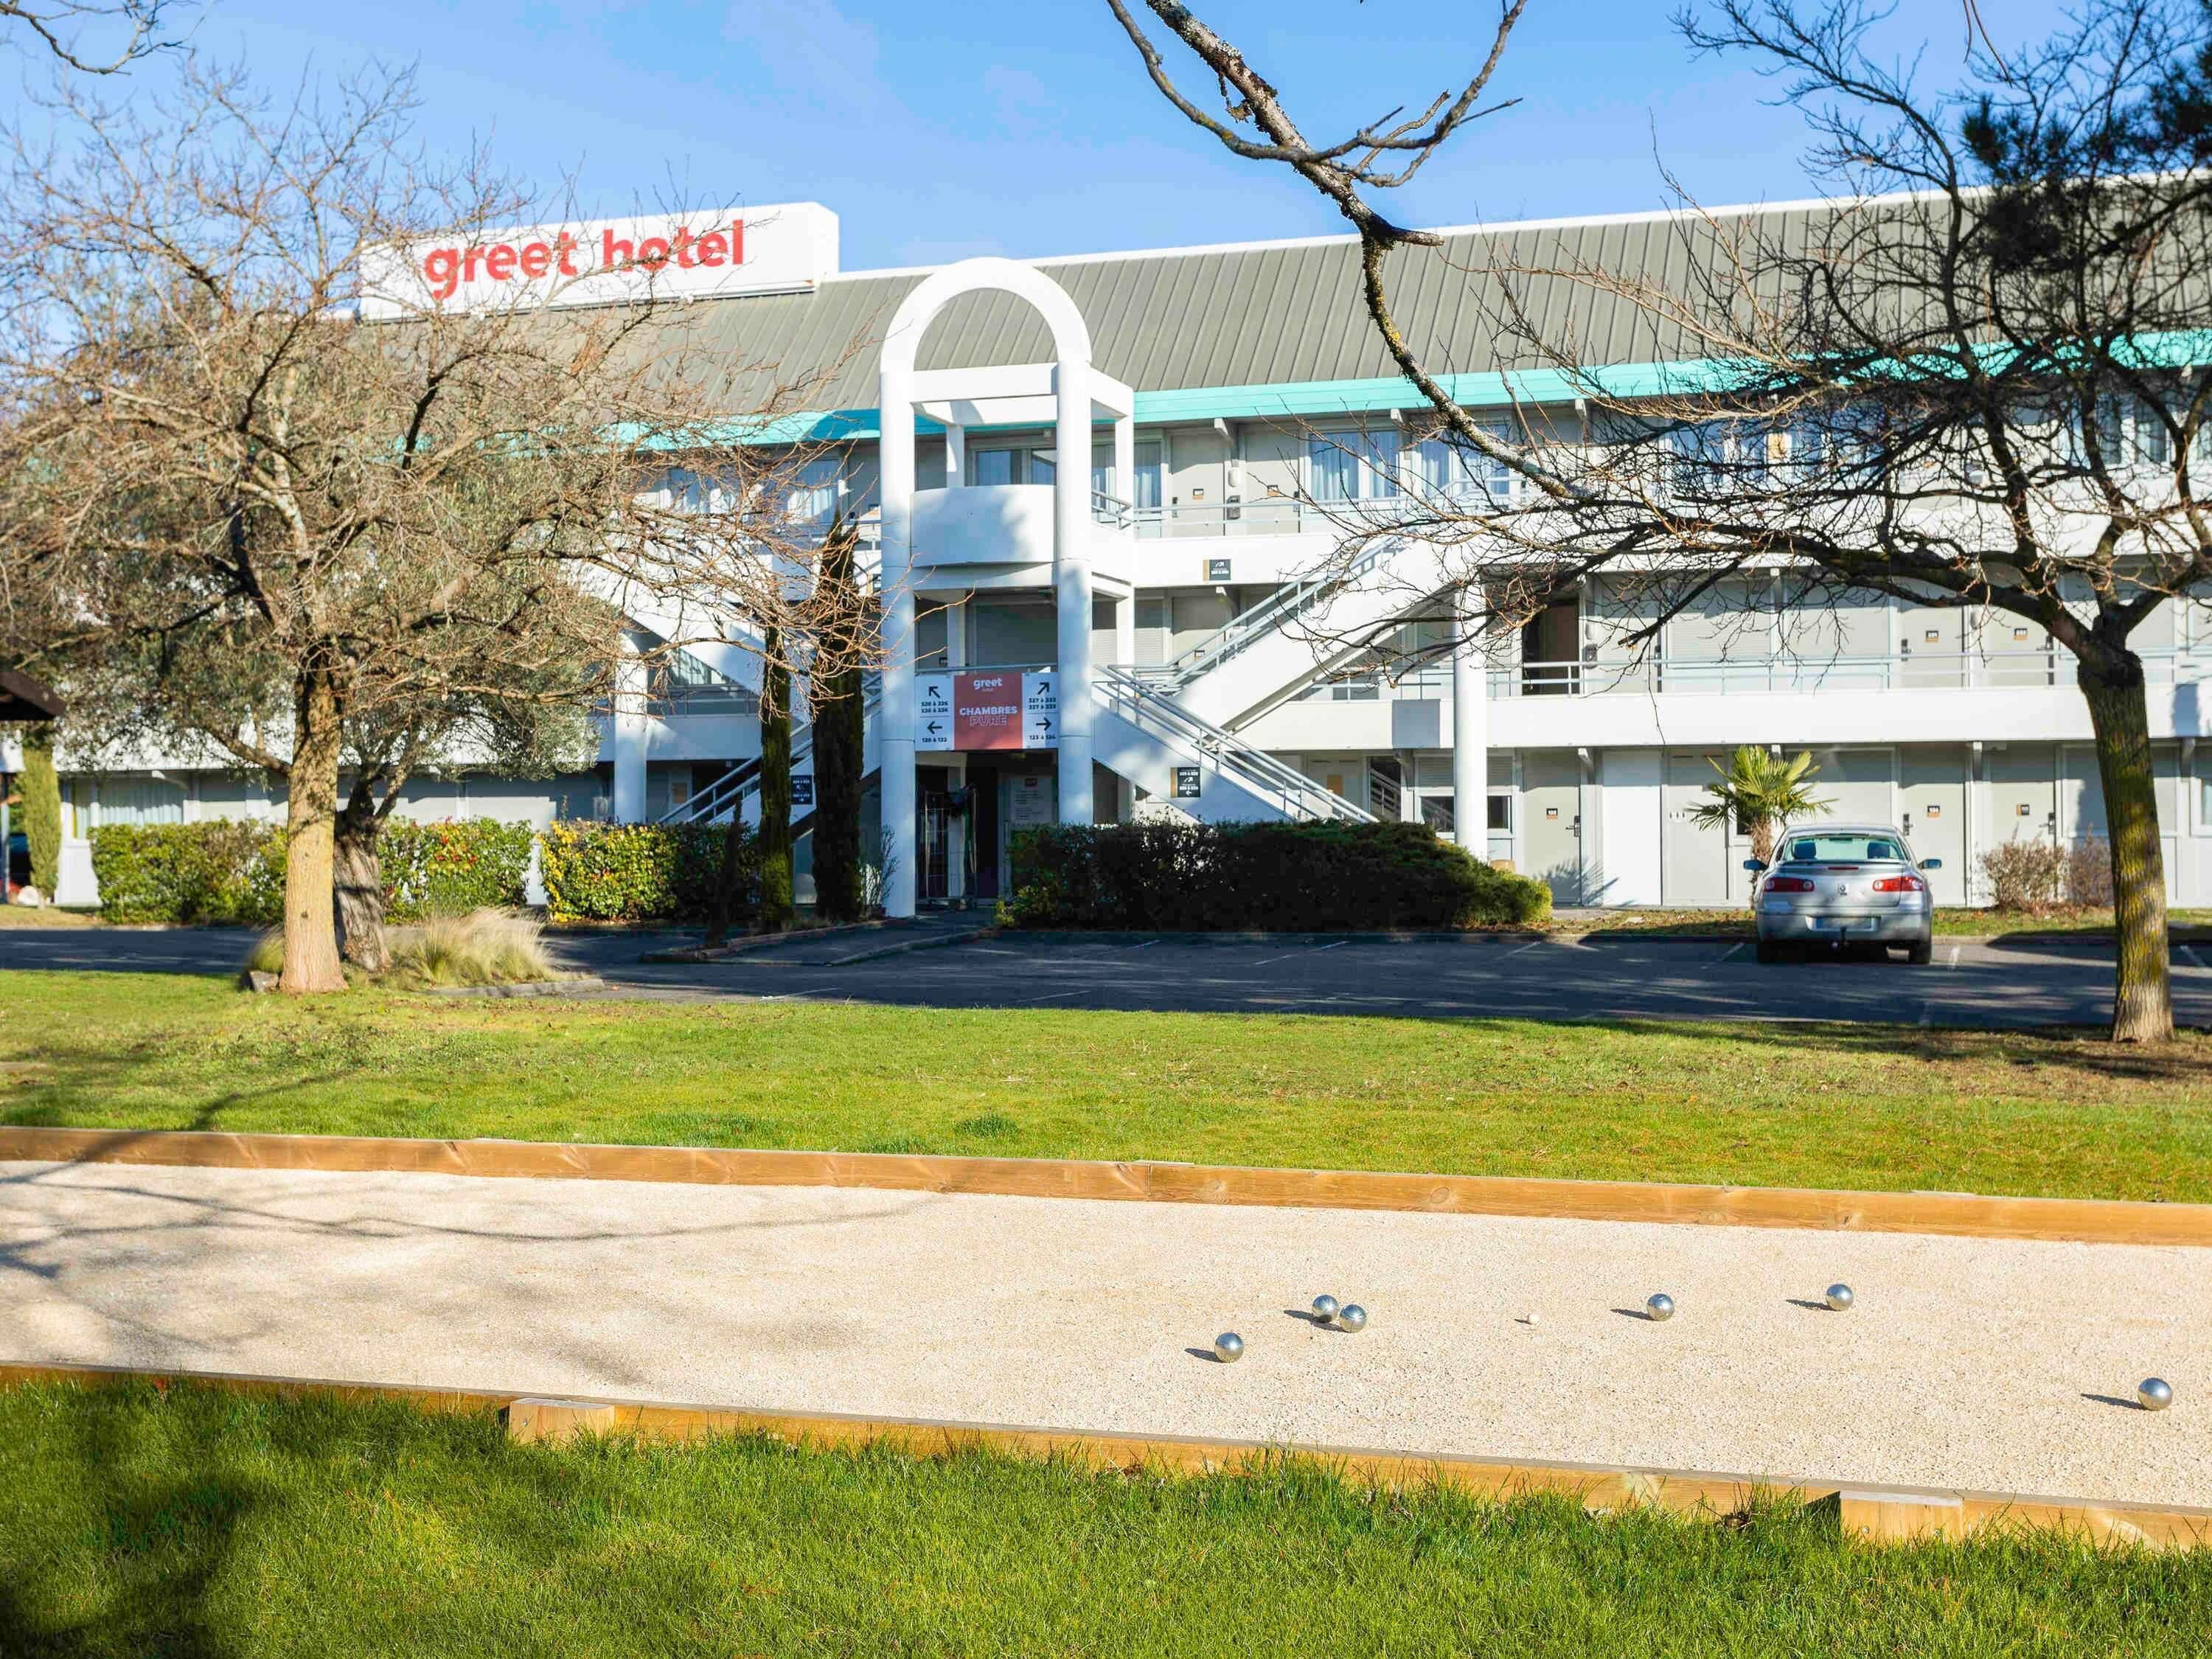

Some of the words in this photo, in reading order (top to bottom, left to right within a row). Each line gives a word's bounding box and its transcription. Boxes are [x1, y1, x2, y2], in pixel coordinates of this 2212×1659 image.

[423, 230, 577, 299] greet
[602, 219, 744, 273] hotel
[973, 678, 1003, 690] greet
[959, 706, 1018, 716] CHAMBRES
